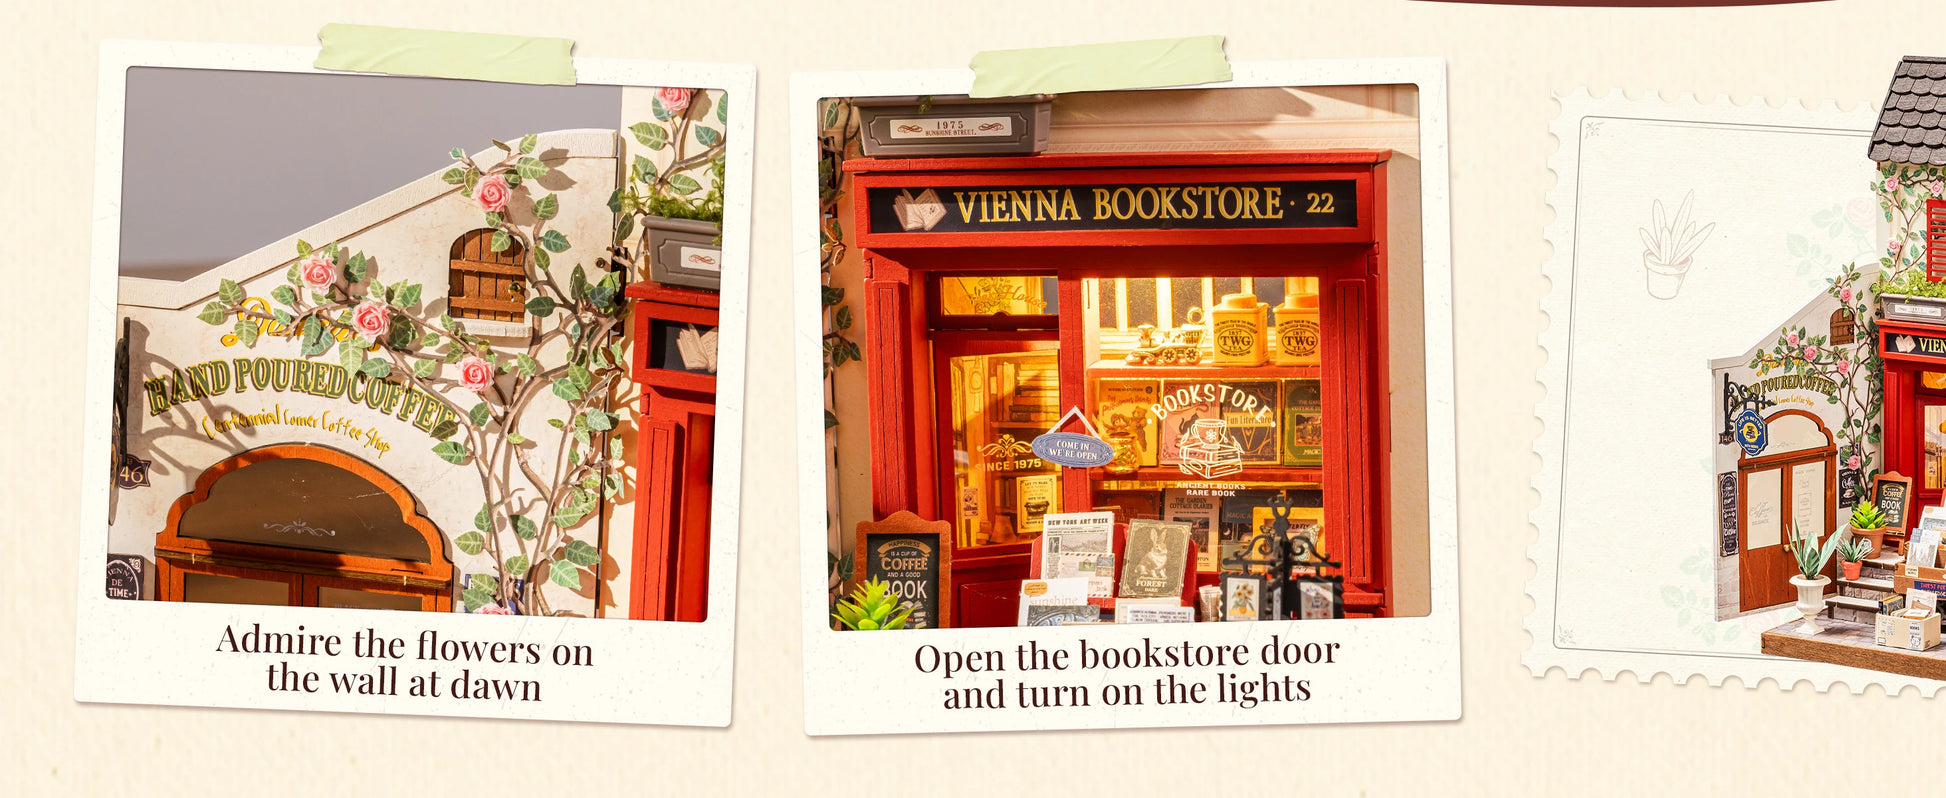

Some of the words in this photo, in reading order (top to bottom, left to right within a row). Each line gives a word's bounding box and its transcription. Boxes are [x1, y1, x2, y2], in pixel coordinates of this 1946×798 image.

[937, 120, 964, 130] 1975
[955, 189, 1082, 224] VIENNA
[1092, 186, 1284, 220] BOOKSTORE
[1305, 192, 1335, 214] 22
[1221, 335, 1251, 347] TWG
[1284, 335, 1316, 347] TWG
[145, 356, 232, 418] HAND
[234, 356, 350, 400] POURED
[1149, 383, 1273, 423] BOOKSTORE
[283, 409, 319, 428] Corner
[321, 410, 364, 441] Coffee
[364, 426, 391, 459] Shop
[1056, 440, 1079, 450] COME
[1080, 442, 1091, 451] IN
[1076, 450, 1098, 461] OPEN
[975, 460, 1010, 472] SINCE
[1014, 458, 1042, 470] 1975
[119, 465, 144, 484] 46
[1177, 481, 1214, 489] ANCIENT
[1211, 489, 1236, 497] BOOK
[1881, 499, 1902, 510] BOOK
[881, 557, 928, 571] COFFEE
[106, 568, 134, 583] IENNA
[111, 578, 123, 587] DE
[1135, 579, 1168, 588] FOREST
[108, 587, 129, 598] TIME
[881, 580, 928, 599] BOOK
